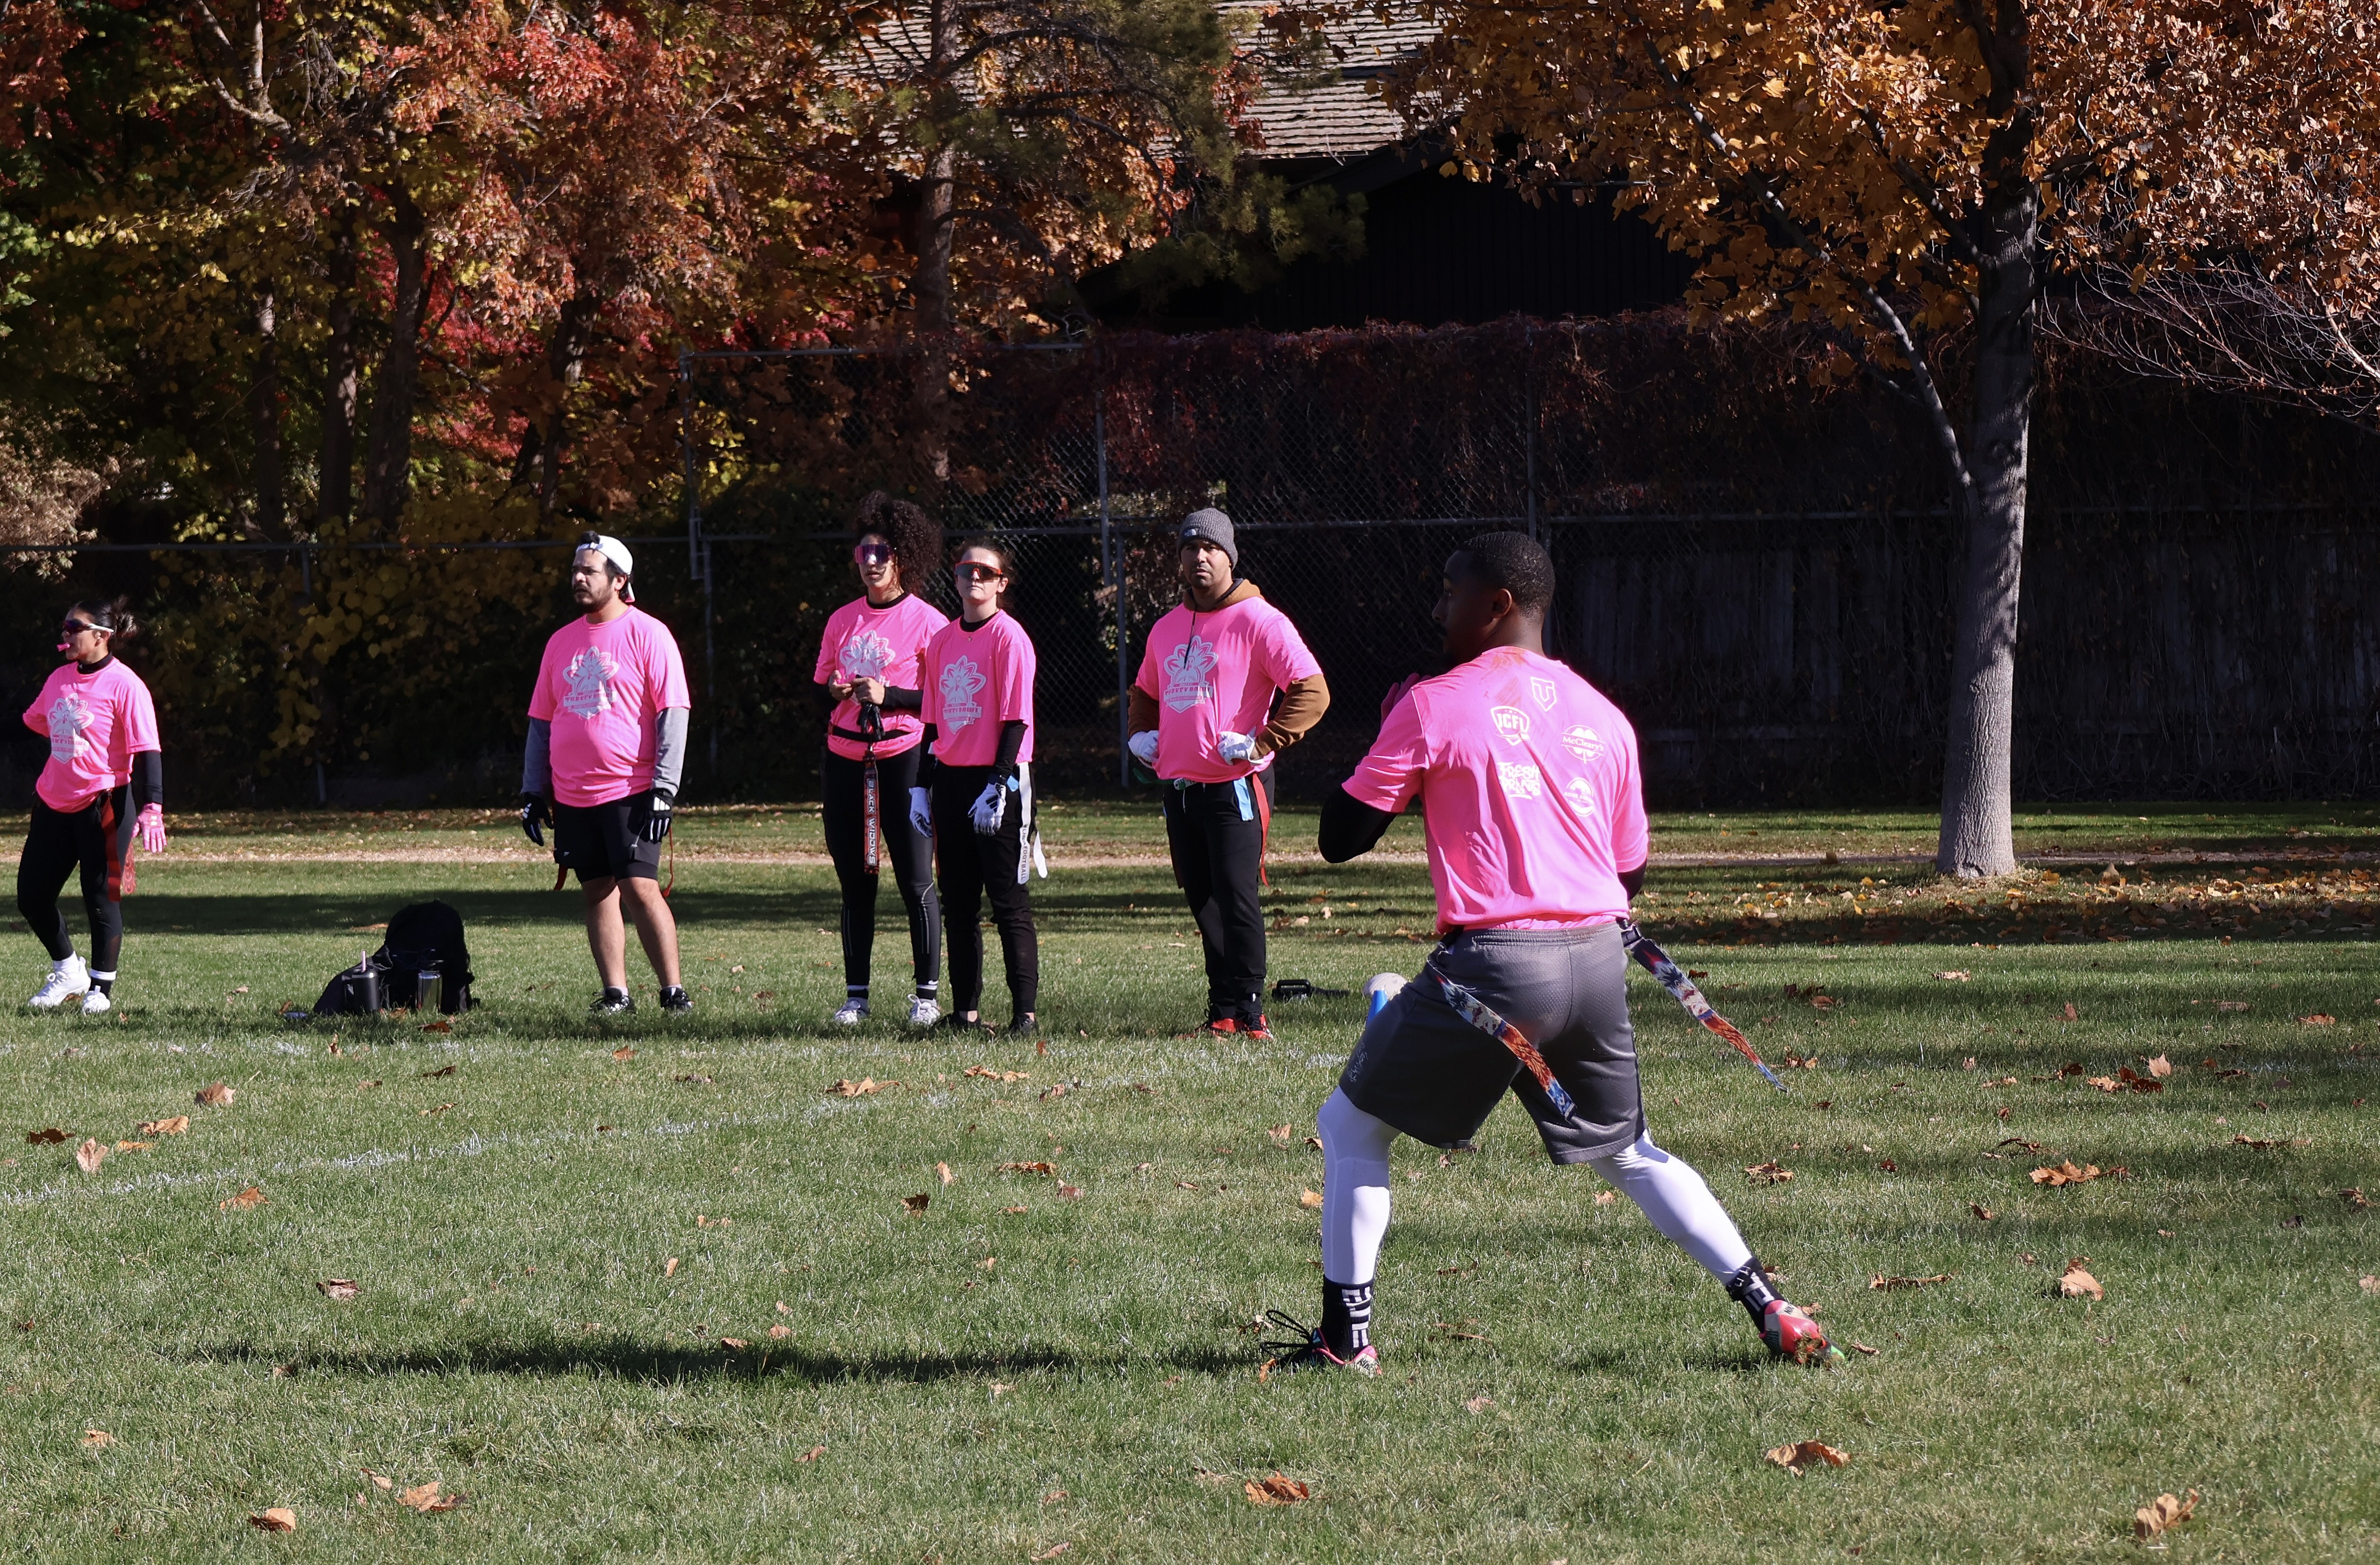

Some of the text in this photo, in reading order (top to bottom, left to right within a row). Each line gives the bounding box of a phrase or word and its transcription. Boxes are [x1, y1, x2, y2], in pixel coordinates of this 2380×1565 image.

[1562, 736, 1603, 752] McCleary's
[1496, 761, 1540, 780] FRESH
[1498, 775, 1541, 797] PRINTS
[867, 779, 877, 866] BLACK WIDOWS
